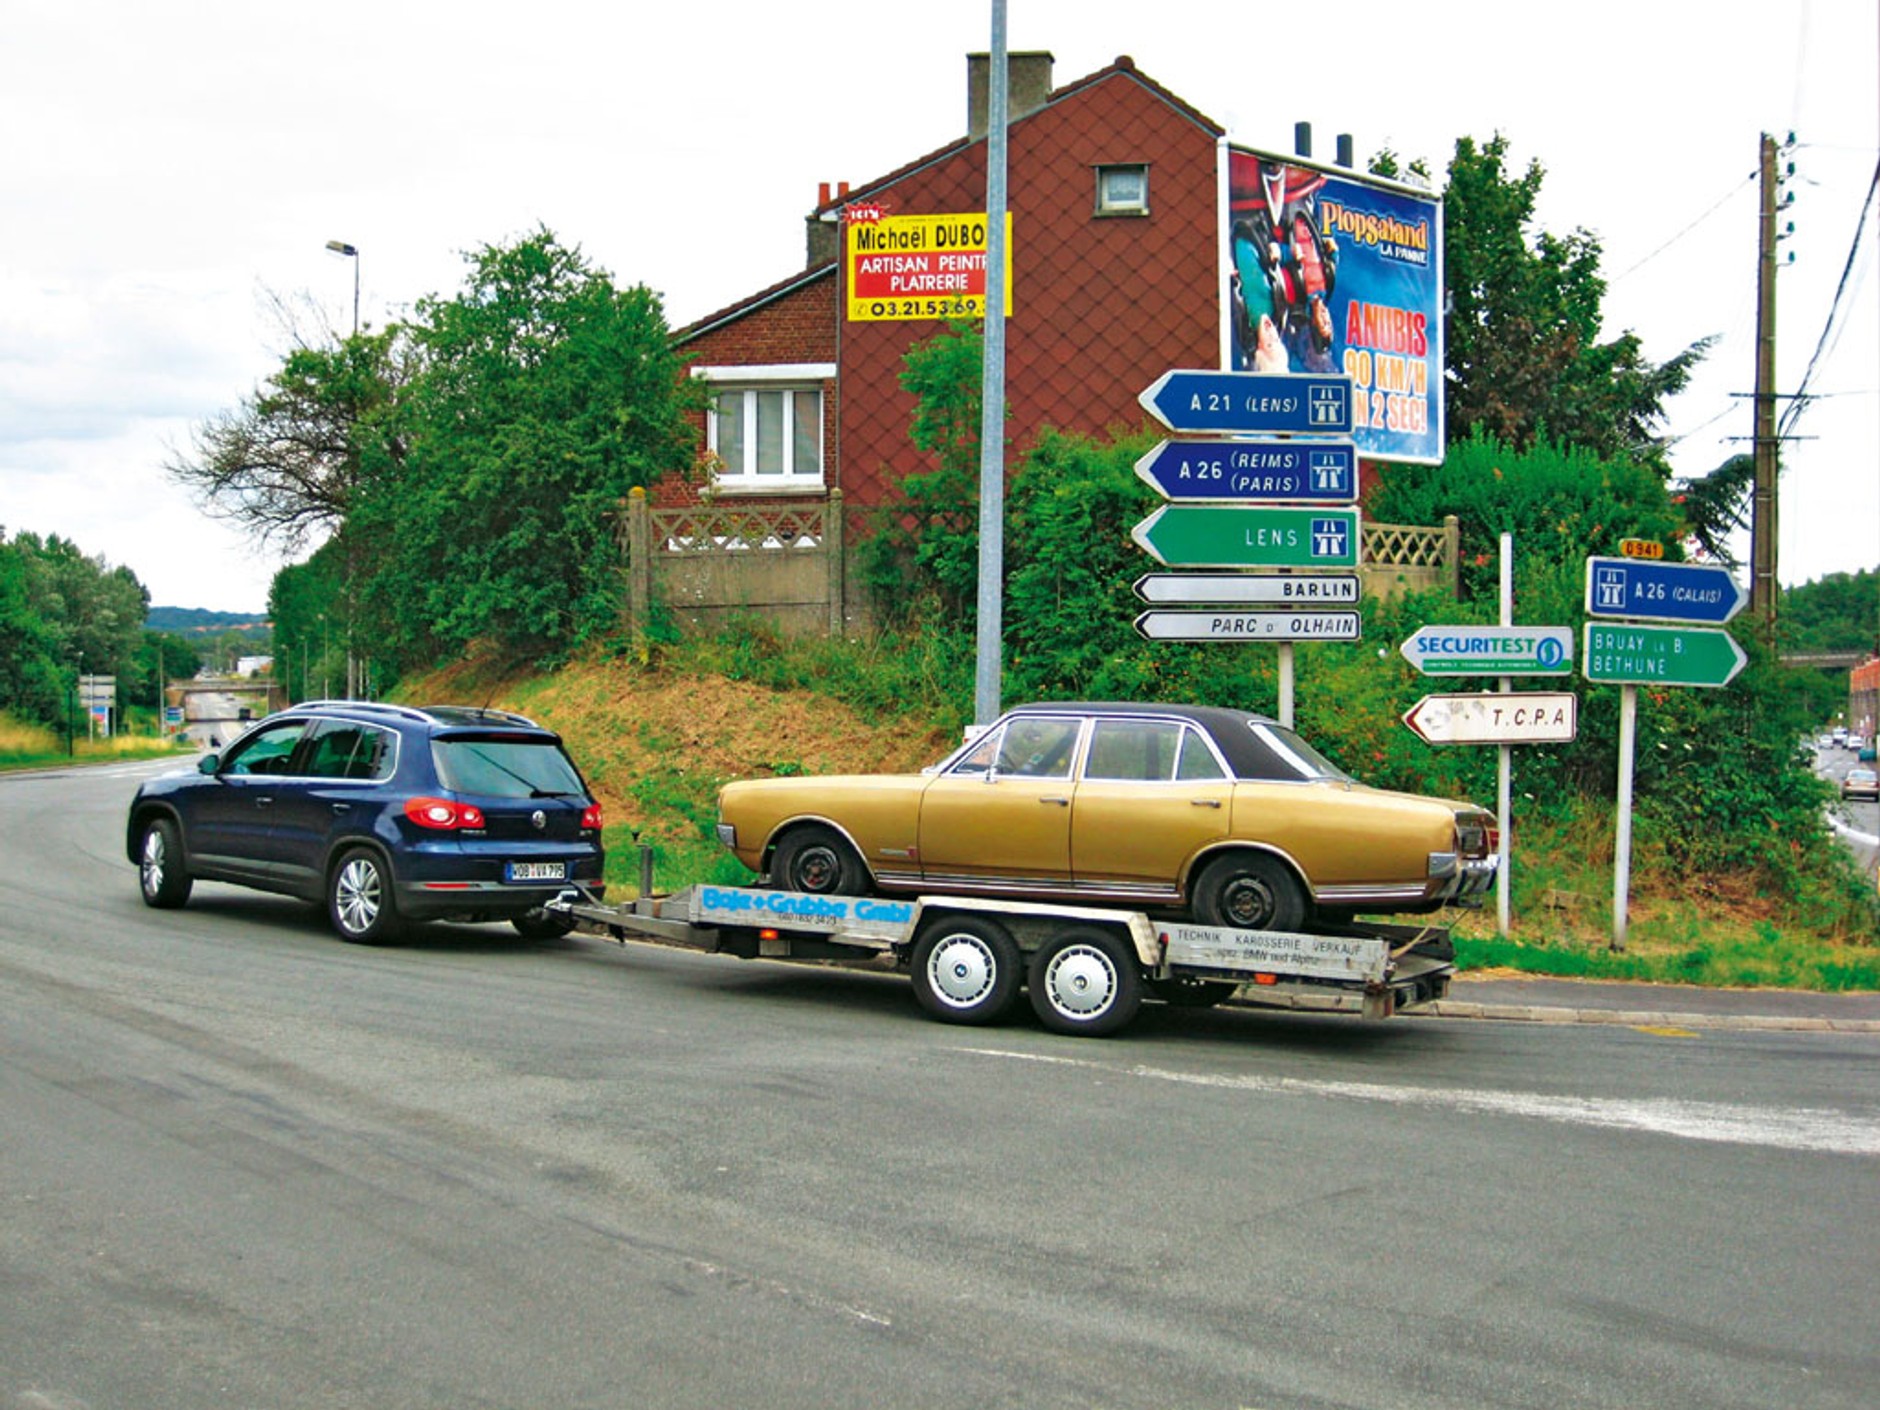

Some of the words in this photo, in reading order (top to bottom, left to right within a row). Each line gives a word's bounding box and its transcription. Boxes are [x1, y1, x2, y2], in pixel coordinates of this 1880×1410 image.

[1320, 201, 1428, 248] Plopsaland
[857, 226, 926, 250] Michaël
[1380, 243, 1393, 256] LA
[860, 256, 929, 274] ARTISAN
[1346, 301, 1427, 356] ANUBIS
[1344, 349, 1371, 387] 90
[1376, 354, 1427, 396] KM/H
[1190, 394, 1201, 411] A
[1209, 394, 1231, 411] 21
[1245, 396, 1298, 413] (LENS)
[1372, 391, 1384, 429] 2
[1387, 393, 1427, 433] SEC!
[1178, 461, 1191, 479] A
[1197, 461, 1222, 479] 26
[1230, 451, 1300, 468] (REIMS)
[1230, 474, 1301, 492] (PARIS)
[1246, 528, 1298, 547] LENS
[1283, 582, 1352, 597] BARLIN
[1634, 582, 1643, 598] A
[1647, 582, 1666, 599] 26
[1672, 586, 1722, 604] (CALAIS)
[1211, 618, 1257, 633] PARC
[1291, 618, 1354, 633] OLHAIN
[1417, 637, 1537, 653] SECURITEST
[1595, 633, 1645, 651] BRUAY
[1177, 929, 1222, 944] TECHNIK
[1235, 931, 1301, 950] KAROSSERIE
[1313, 941, 1362, 956] VERKAUF
